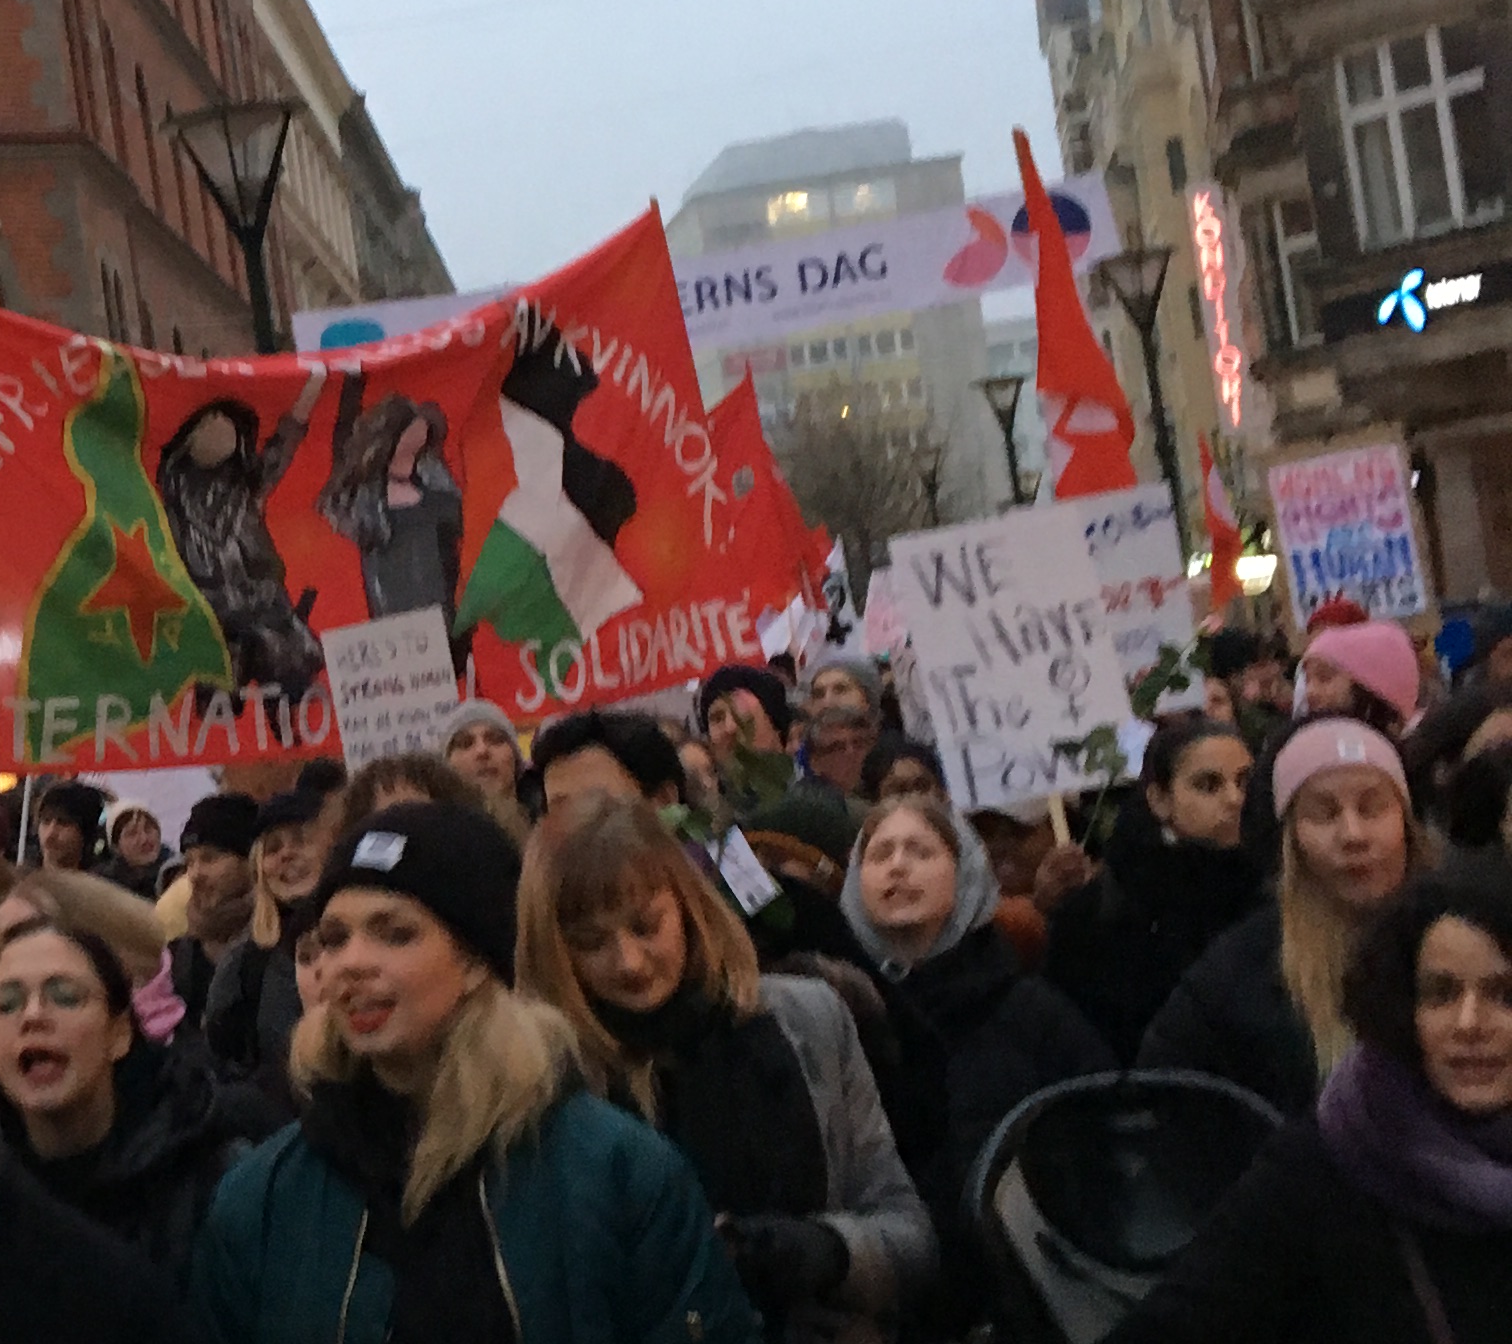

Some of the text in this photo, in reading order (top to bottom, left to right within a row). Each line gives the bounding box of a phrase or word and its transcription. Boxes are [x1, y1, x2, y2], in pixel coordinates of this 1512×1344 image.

[797, 242, 888, 296] DAG
[499, 295, 557, 356] AV
[909, 535, 1010, 608] WE
